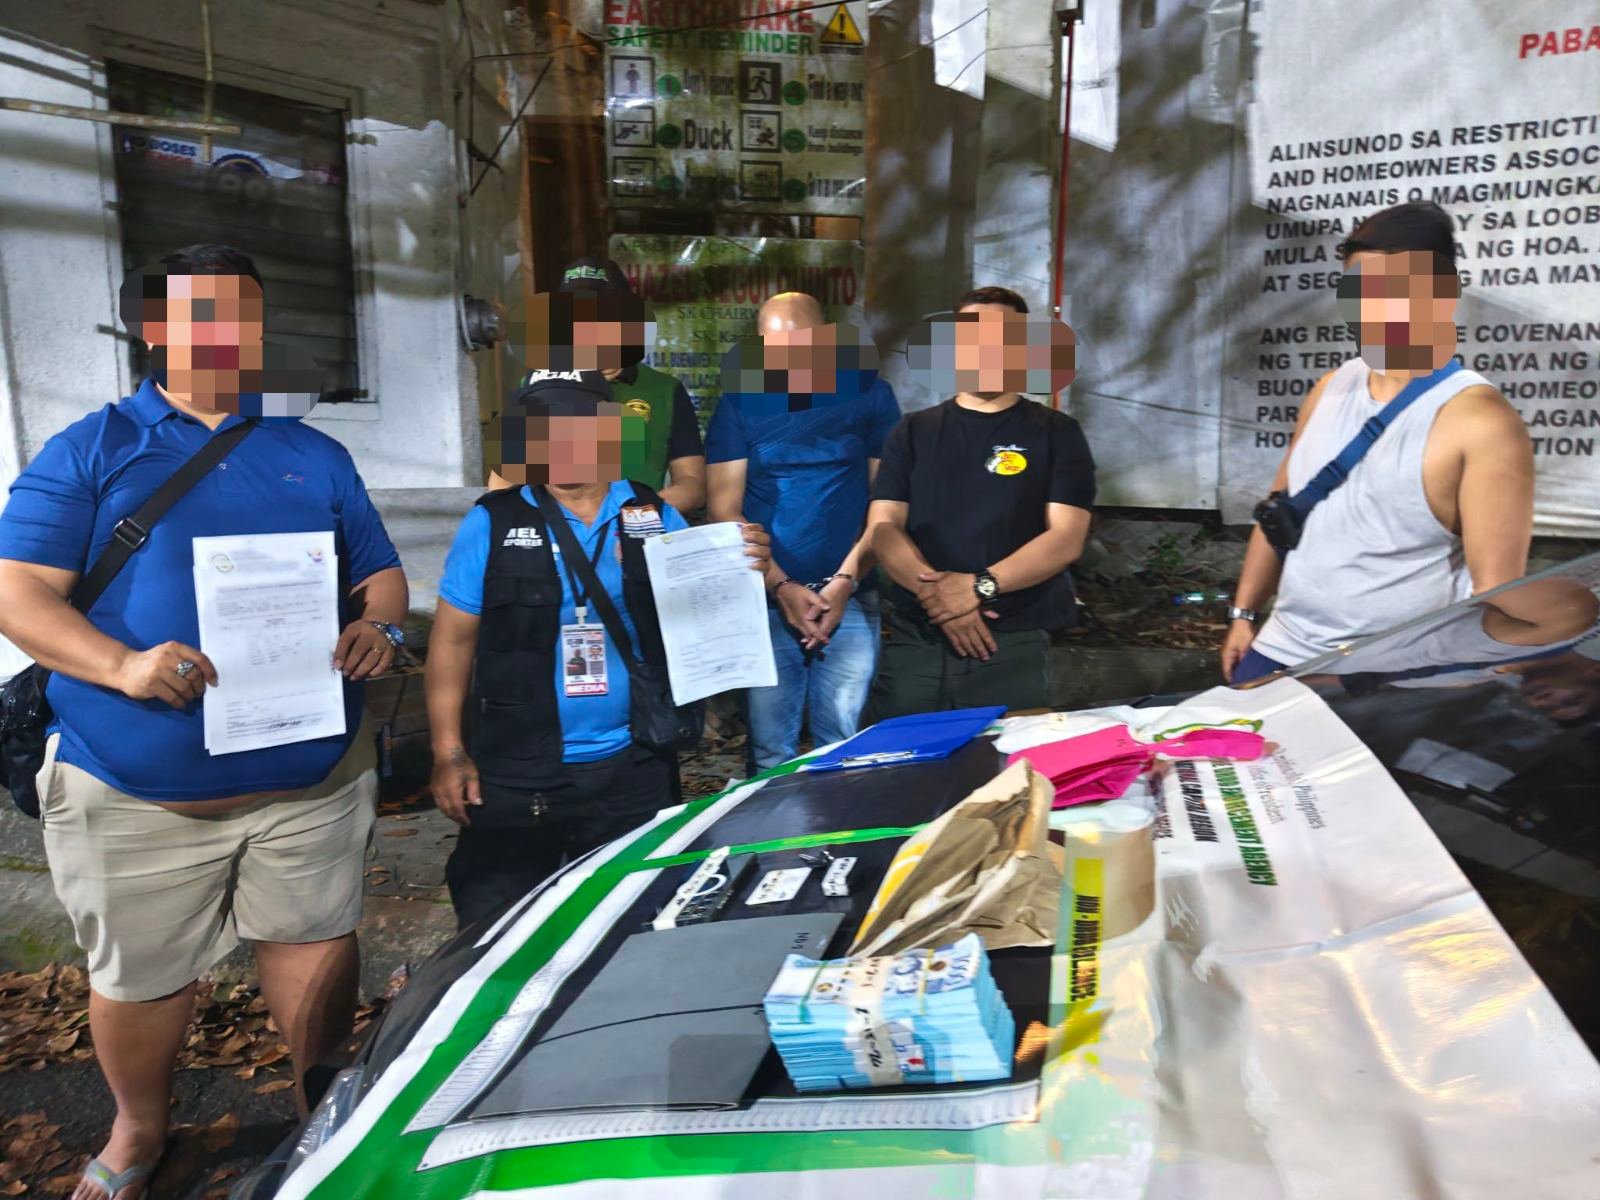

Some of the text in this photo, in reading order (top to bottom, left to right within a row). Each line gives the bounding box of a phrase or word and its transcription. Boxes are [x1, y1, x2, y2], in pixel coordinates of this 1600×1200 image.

[606, 0, 815, 33] EARTHQUAKE
[606, 26, 814, 55] SAFETY REMINDER
[1518, 25, 1600, 60] PABA
[684, 118, 735, 151] Duck
[1269, 114, 1600, 163] ALINSUNOD SA RESTRICTI
[1268, 144, 1600, 189] AND HOMEOWNERS ASSOC
[1266, 187, 1399, 215] NAGNANAIS
[1431, 174, 1600, 205] MAGMUNGK
[1265, 218, 1344, 242] UMUPA
[1482, 211, 1517, 230] SA
[1526, 205, 1600, 227] LOOB
[1264, 245, 1328, 267] MULA
[1477, 238, 1514, 257] NG
[1524, 235, 1591, 256] HOA.
[1262, 275, 1290, 293] AT
[1298, 270, 1341, 290] SEG
[1480, 266, 1539, 287] MGA
[1548, 263, 1600, 285] MAY
[703, 307, 760, 321] CHAIRW
[1259, 326, 1312, 346] ANG
[1316, 323, 1357, 343] RES
[1474, 321, 1600, 344] COVENAN
[1258, 352, 1291, 370] NG
[1298, 349, 1361, 369] TERM
[1473, 351, 1539, 371] GAYA
[1549, 349, 1588, 369] NG
[1500, 378, 1600, 400] HOMEO
[1256, 406, 1600, 428] PAR AGAN
[1529, 437, 1594, 456] TION
[1181, 782, 1208, 815] CAPITAL
[1293, 784, 1326, 830] Philippines
[1187, 811, 1220, 843] REGION
[1213, 764, 1279, 886] DRUG ENFORCEMENT AGENCY
